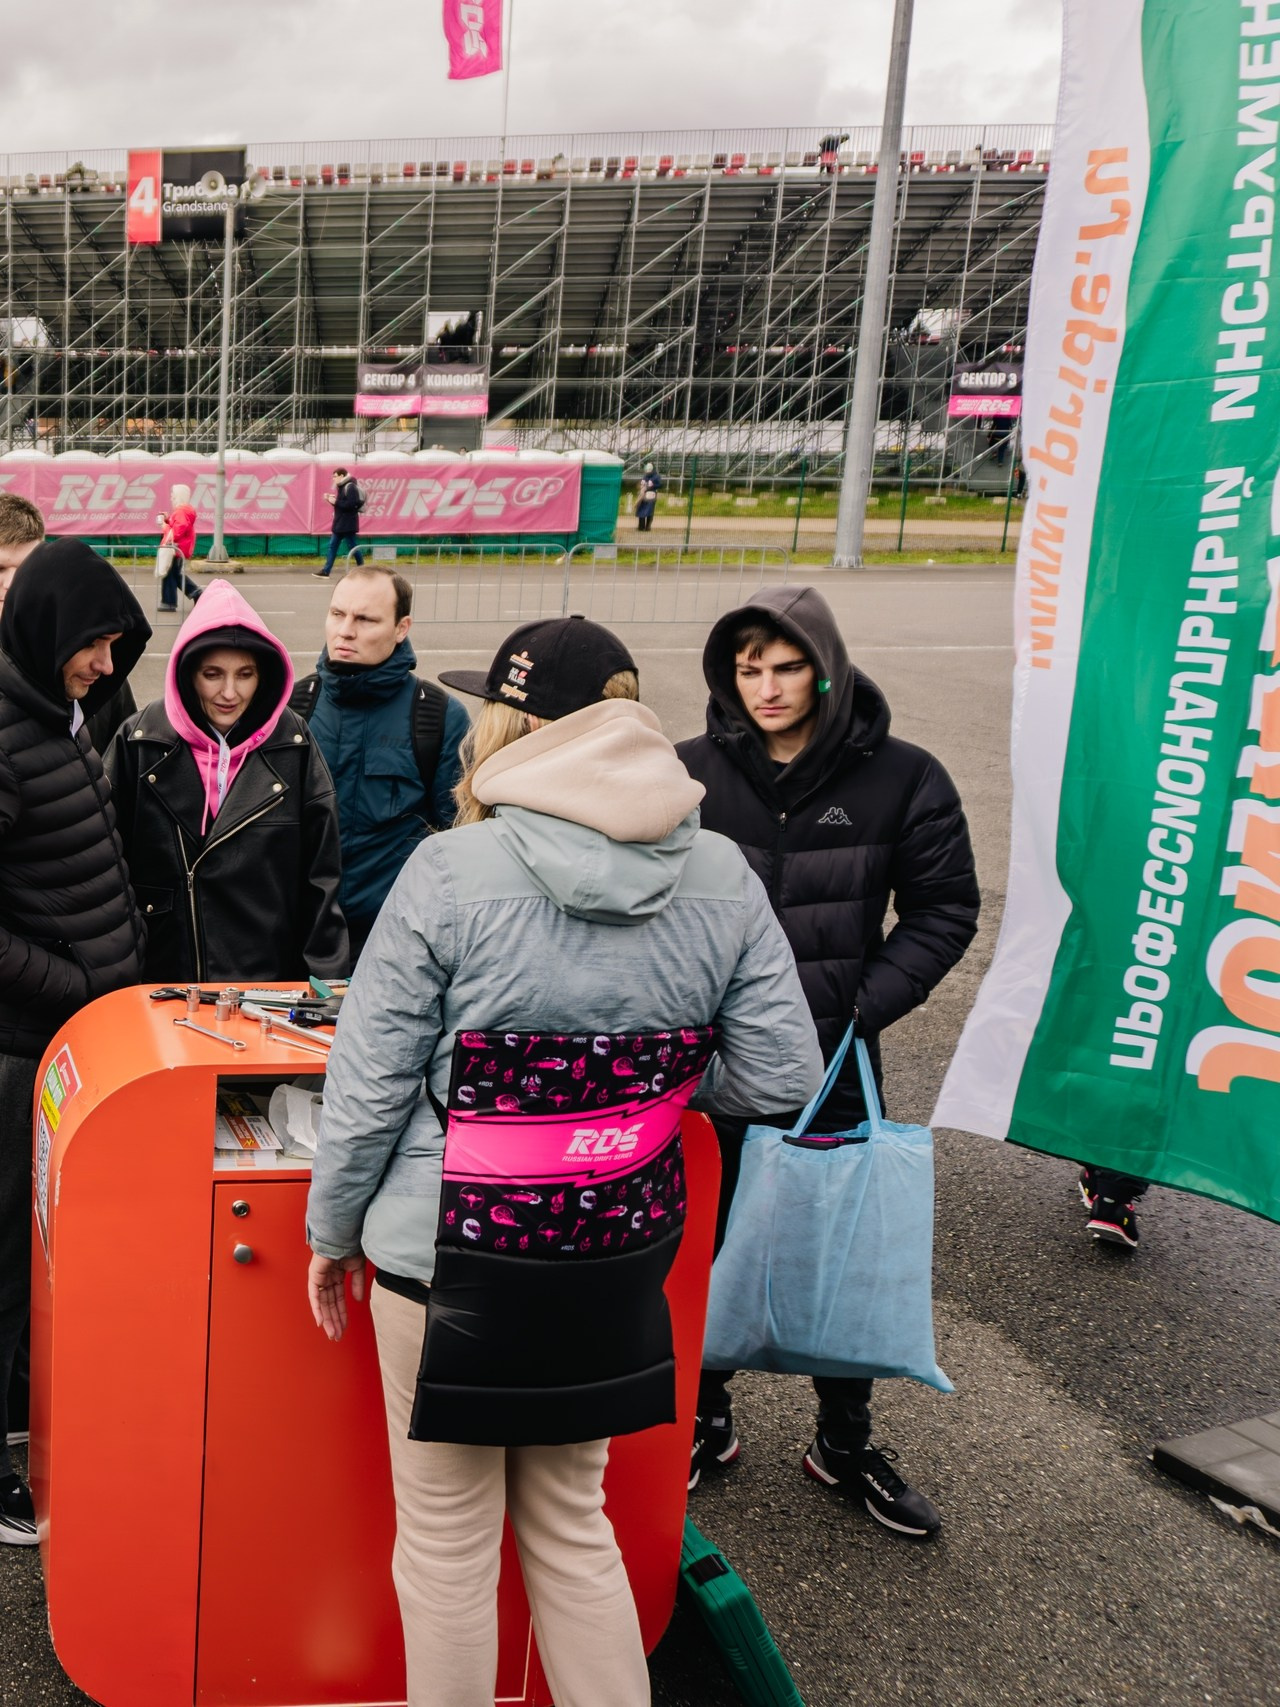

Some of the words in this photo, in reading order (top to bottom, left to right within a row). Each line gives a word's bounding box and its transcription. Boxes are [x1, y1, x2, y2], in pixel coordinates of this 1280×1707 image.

[460, 0, 488, 58] DS
[130, 176, 158, 215] 4
[364, 374, 405, 386] СЕКТОР
[408, 374, 416, 386] 4
[427, 374, 485, 386] КОМФОРТ
[961, 372, 1007, 386] СЕКТОР
[1008, 373, 1017, 386] 3
[978, 399, 1014, 411] RDS
[53, 474, 164, 510] RDS
[399, 478, 516, 517] RDS
[512, 477, 565, 505] GP
[48, 513, 87, 521] RUSSIAN
[89, 513, 117, 521] DRIFT
[118, 512, 148, 520] SERIES
[251, 512, 281, 520] SERIES
[566, 1123, 645, 1155] RDS
